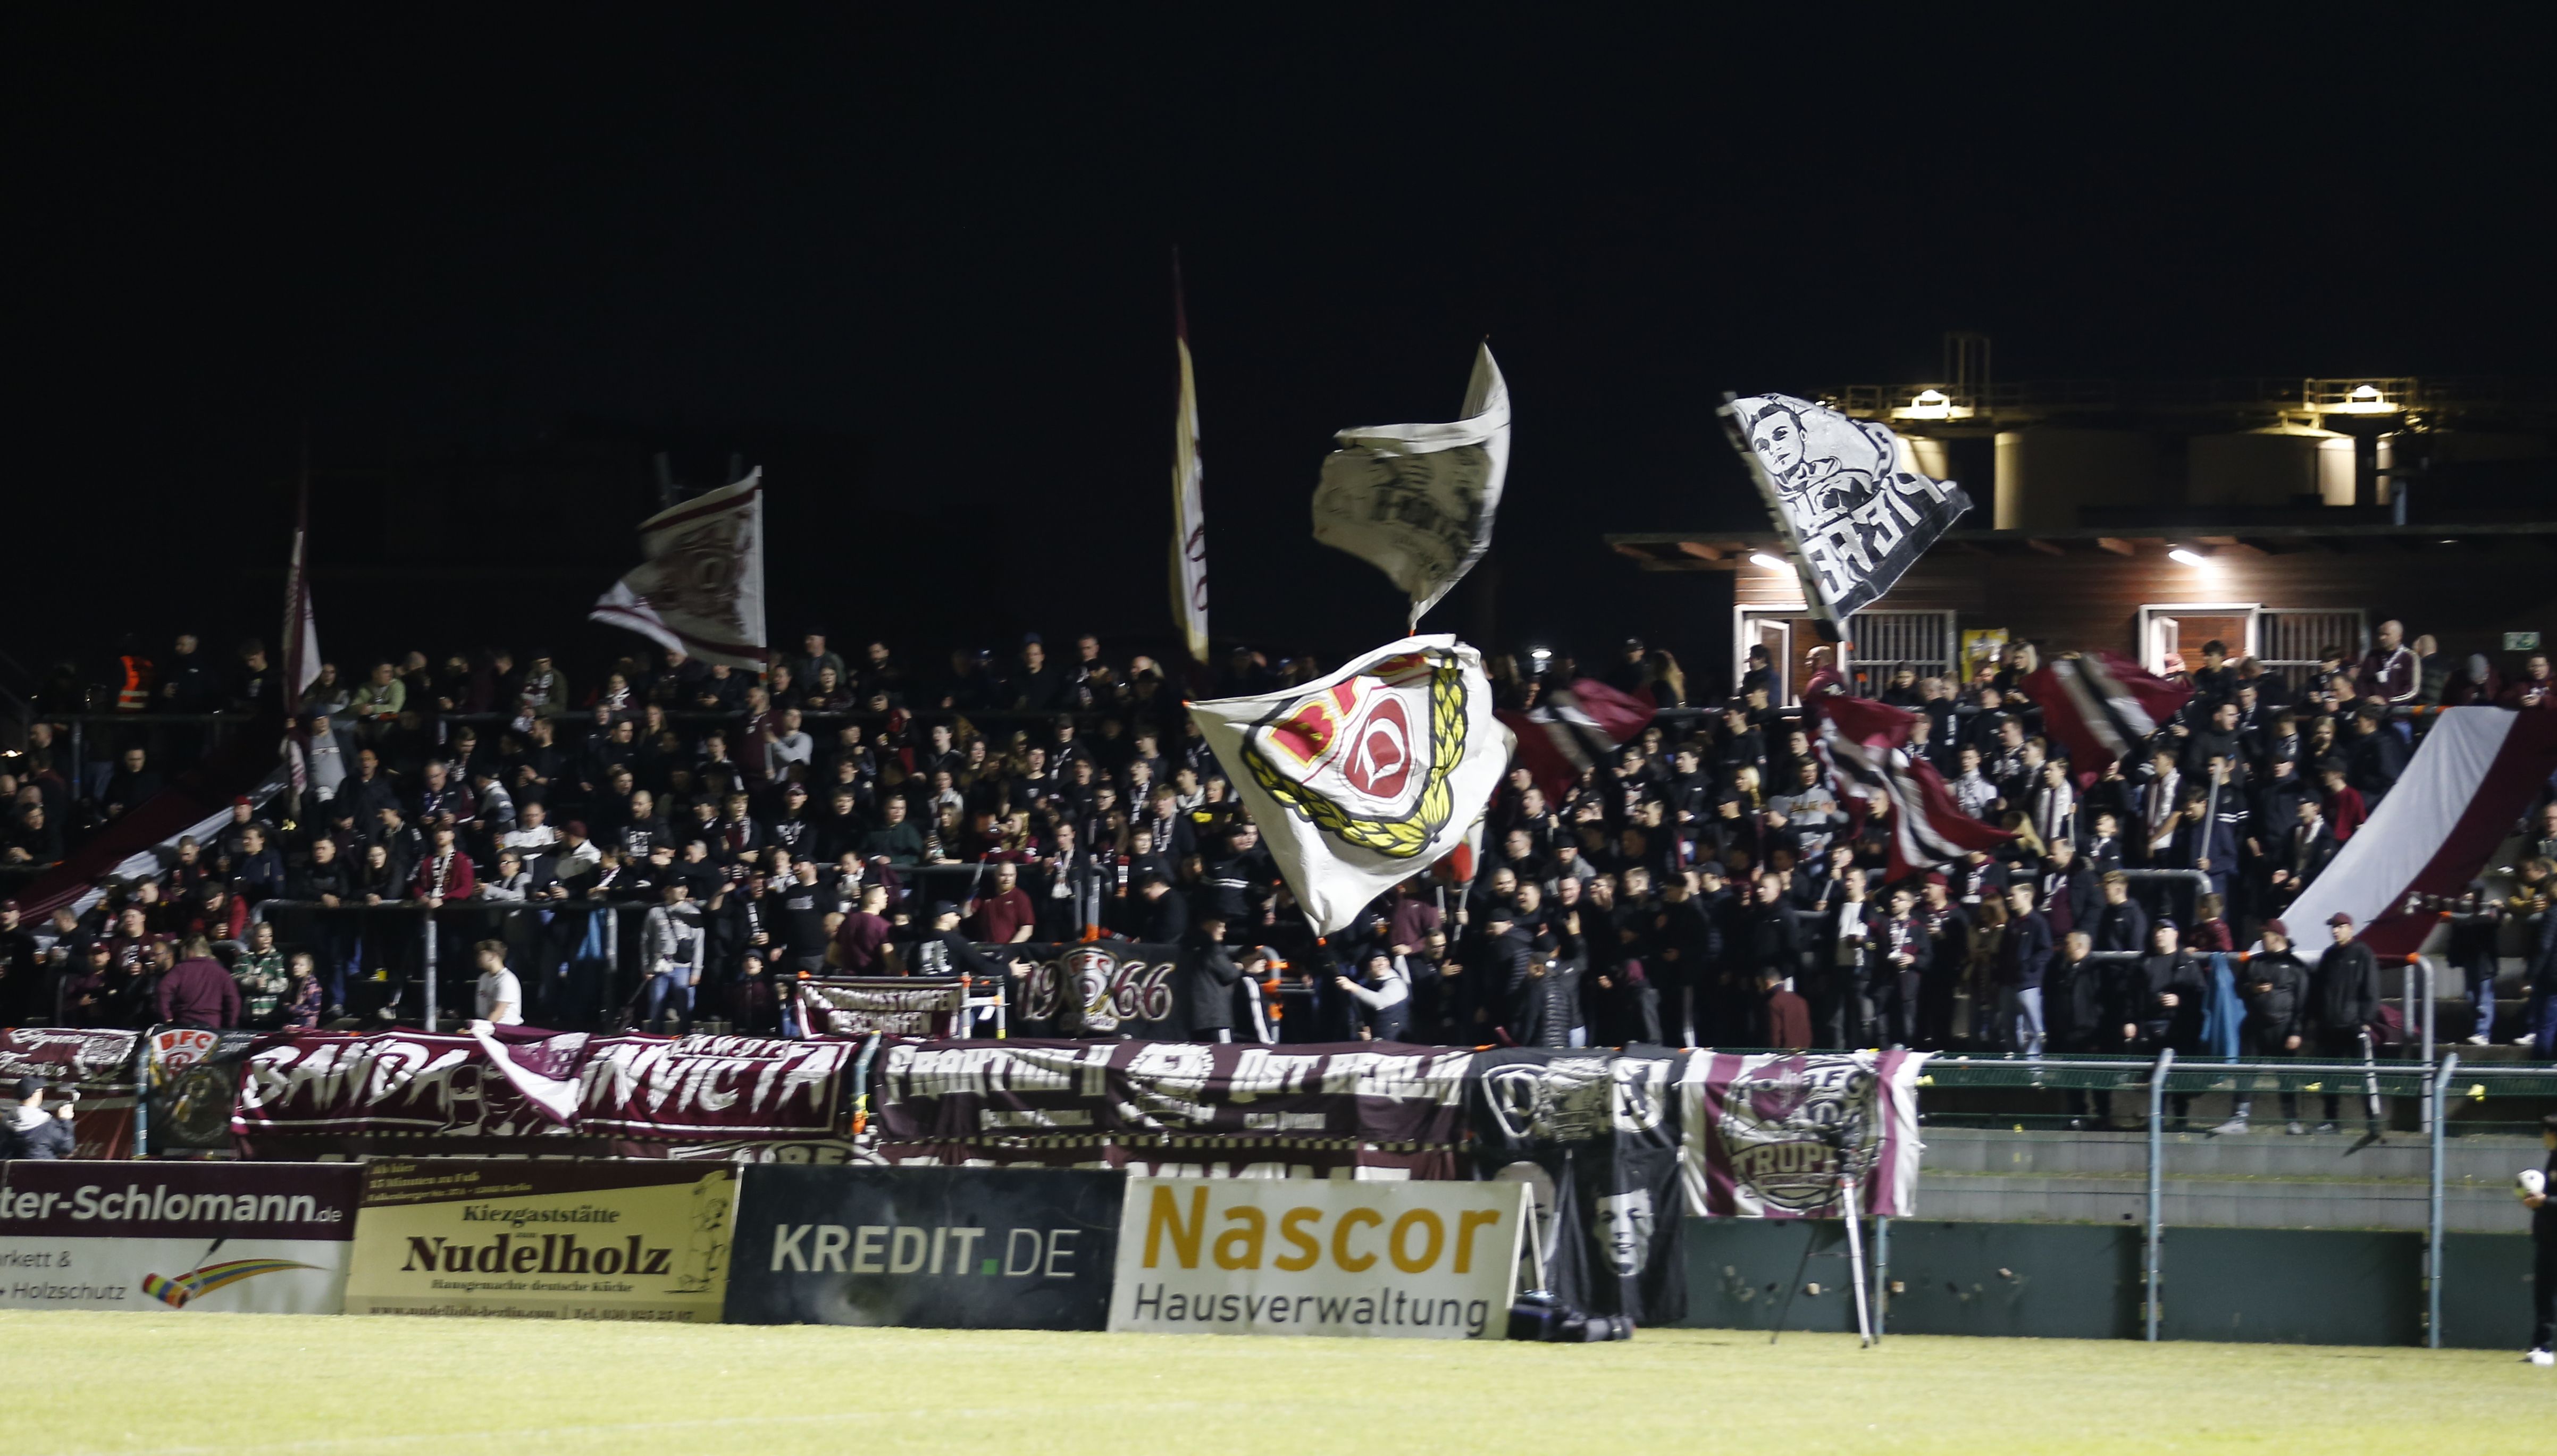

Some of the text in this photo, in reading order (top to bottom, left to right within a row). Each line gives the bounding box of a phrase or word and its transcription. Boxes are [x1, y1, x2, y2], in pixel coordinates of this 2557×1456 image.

[160, 1030, 212, 1050] BFC
[462, 1203, 621, 1228] Kiezgaststätte
[1142, 1185, 1502, 1274] Nascor
[0, 1250, 52, 1267] rkett
[401, 1232, 673, 1275] Nudelholz
[770, 1224, 1082, 1277] KREDIT.DE
[11, 1282, 128, 1300] Holzschutz
[531, 1280, 589, 1291] deutsche
[591, 1280, 634, 1292] Küche
[1133, 1283, 1489, 1337] Hausverwaltung
